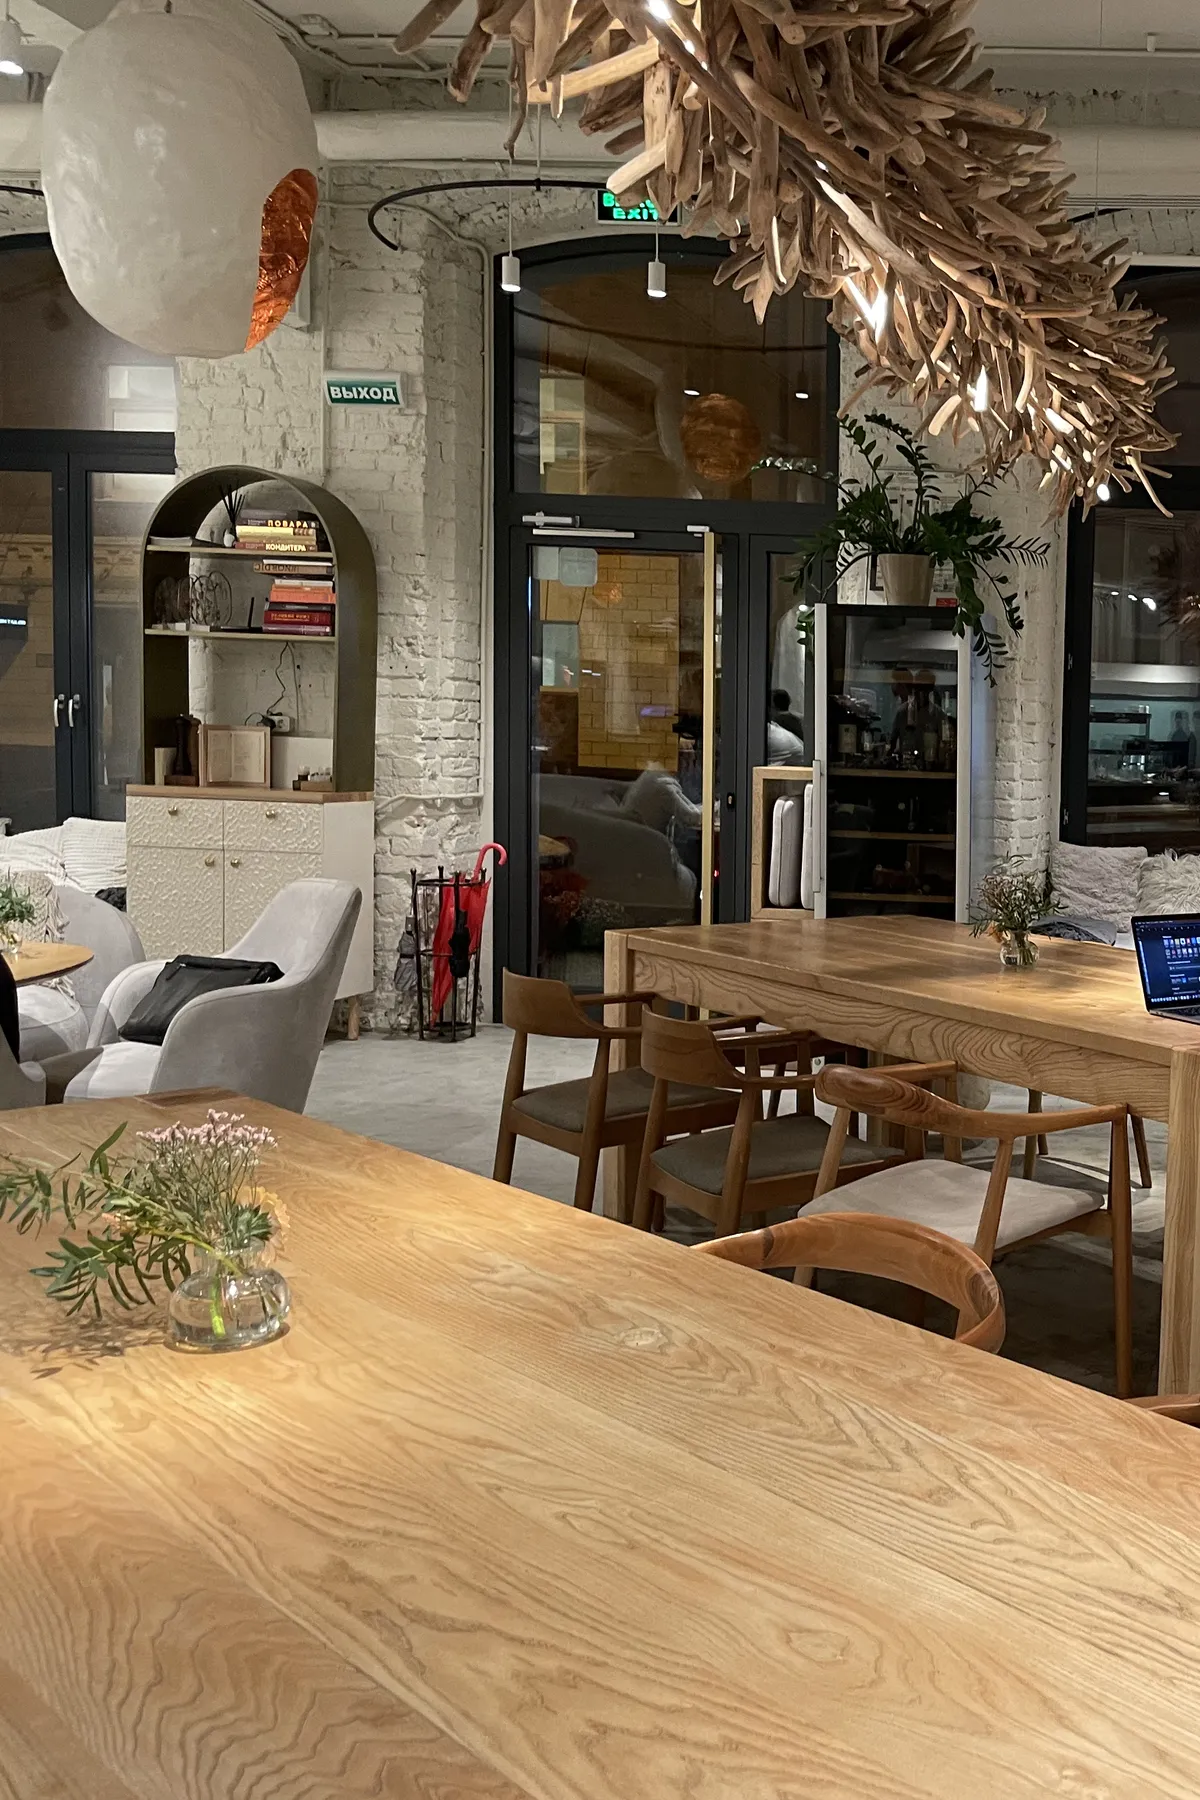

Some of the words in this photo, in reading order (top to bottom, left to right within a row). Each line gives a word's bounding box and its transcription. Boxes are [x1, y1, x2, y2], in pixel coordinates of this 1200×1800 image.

[329, 386, 397, 402] ВЫХОД
[267, 519, 308, 528] ПОВАРА
[265, 543, 307, 552] КОНДИТЕРА
